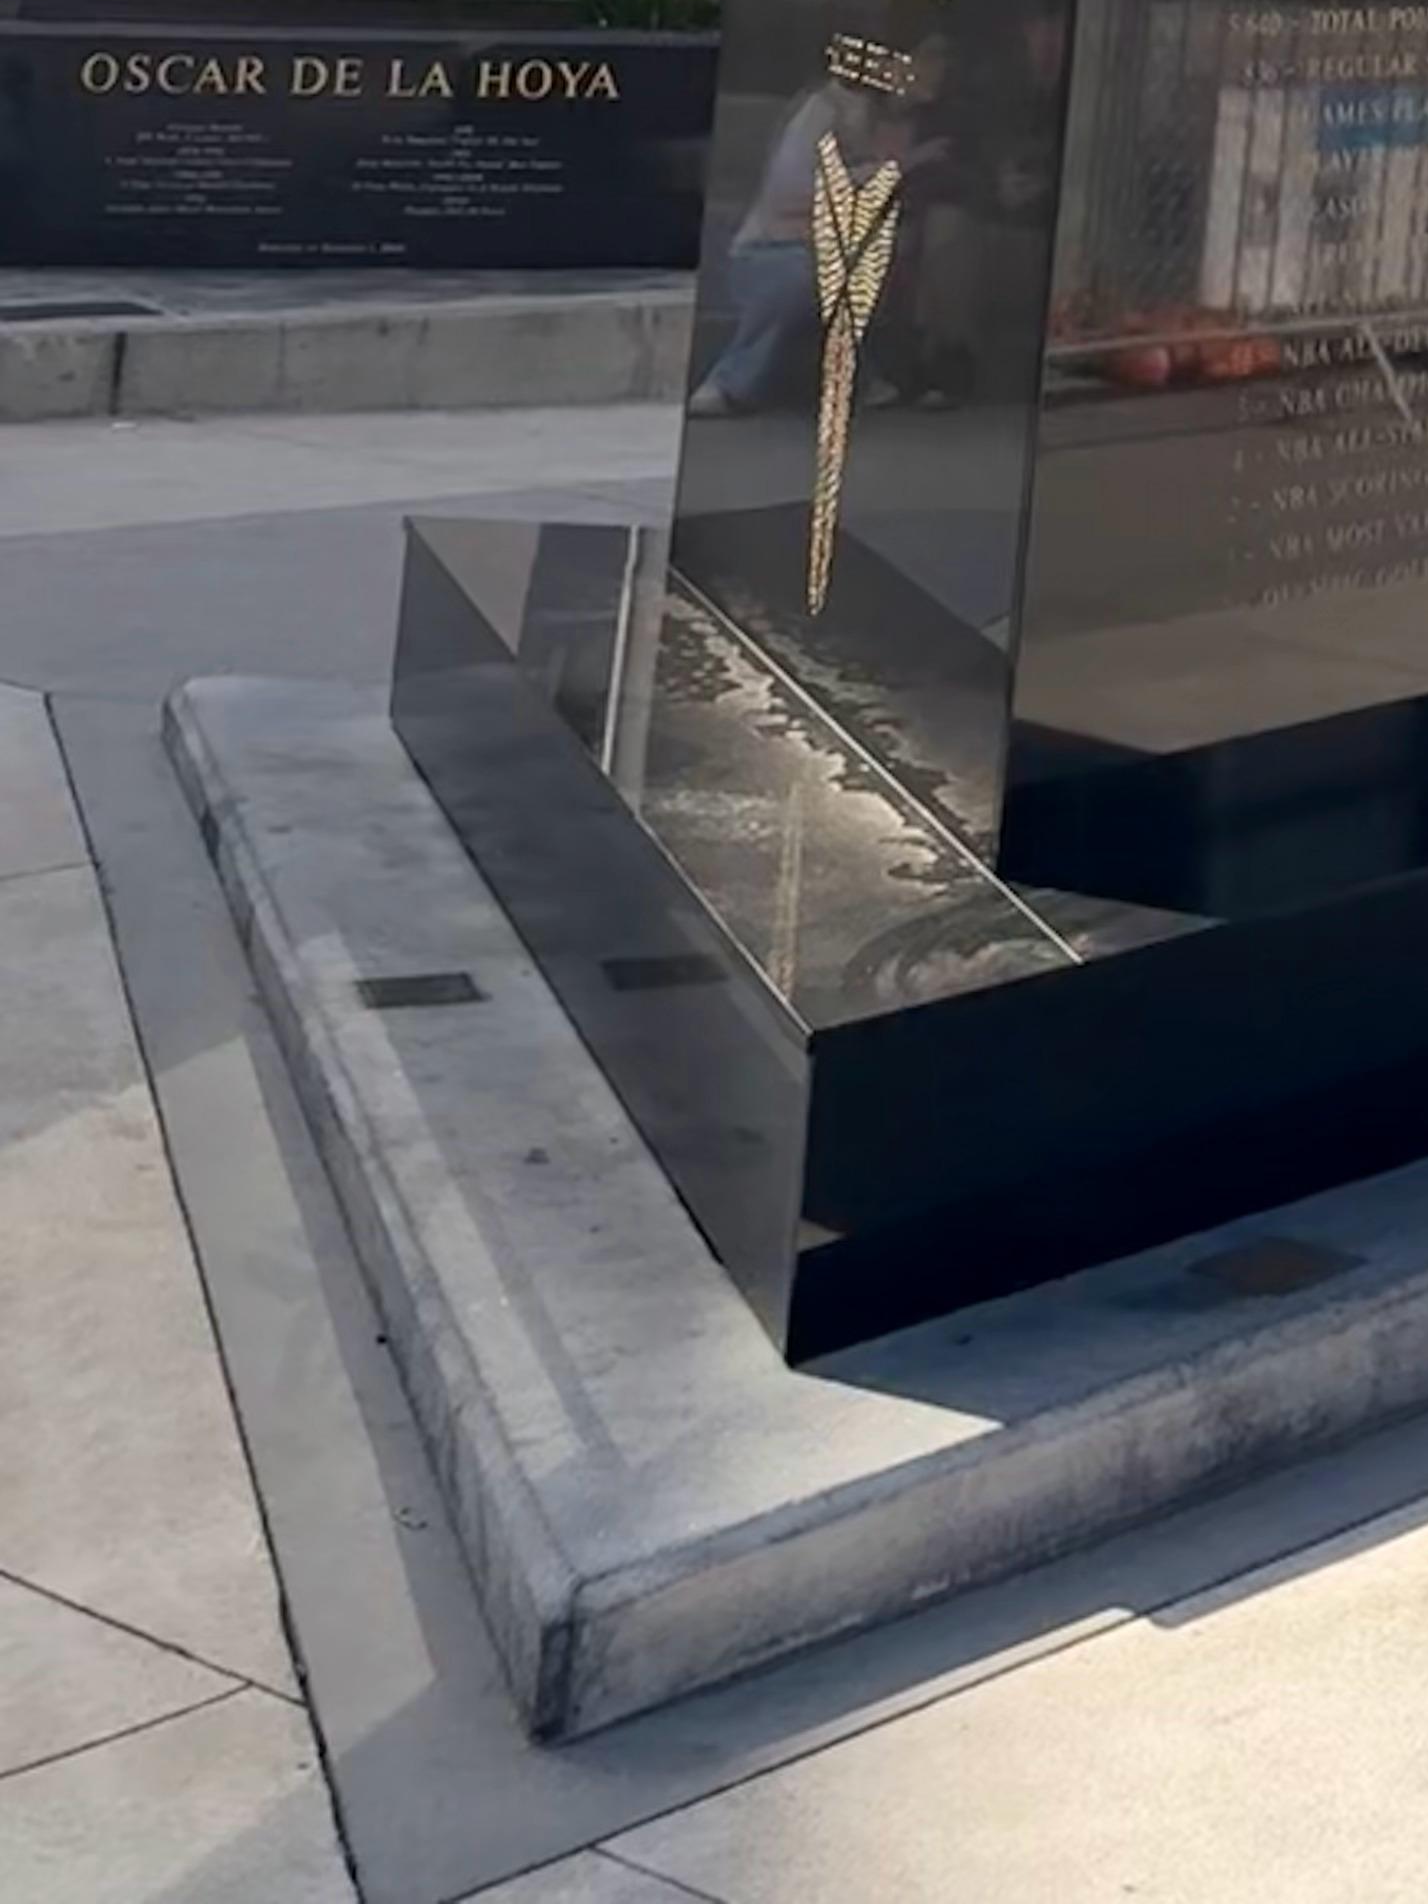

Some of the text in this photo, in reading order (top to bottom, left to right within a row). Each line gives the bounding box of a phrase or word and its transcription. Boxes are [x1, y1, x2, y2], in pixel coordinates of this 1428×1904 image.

[1309, 6, 1383, 34] TOTAL
[80, 53, 621, 101] OSCAR DE LA HOYA
[1307, 52, 1418, 80] REGULAR
[1284, 337, 1333, 369] NBA
[1280, 392, 1326, 427] NBA
